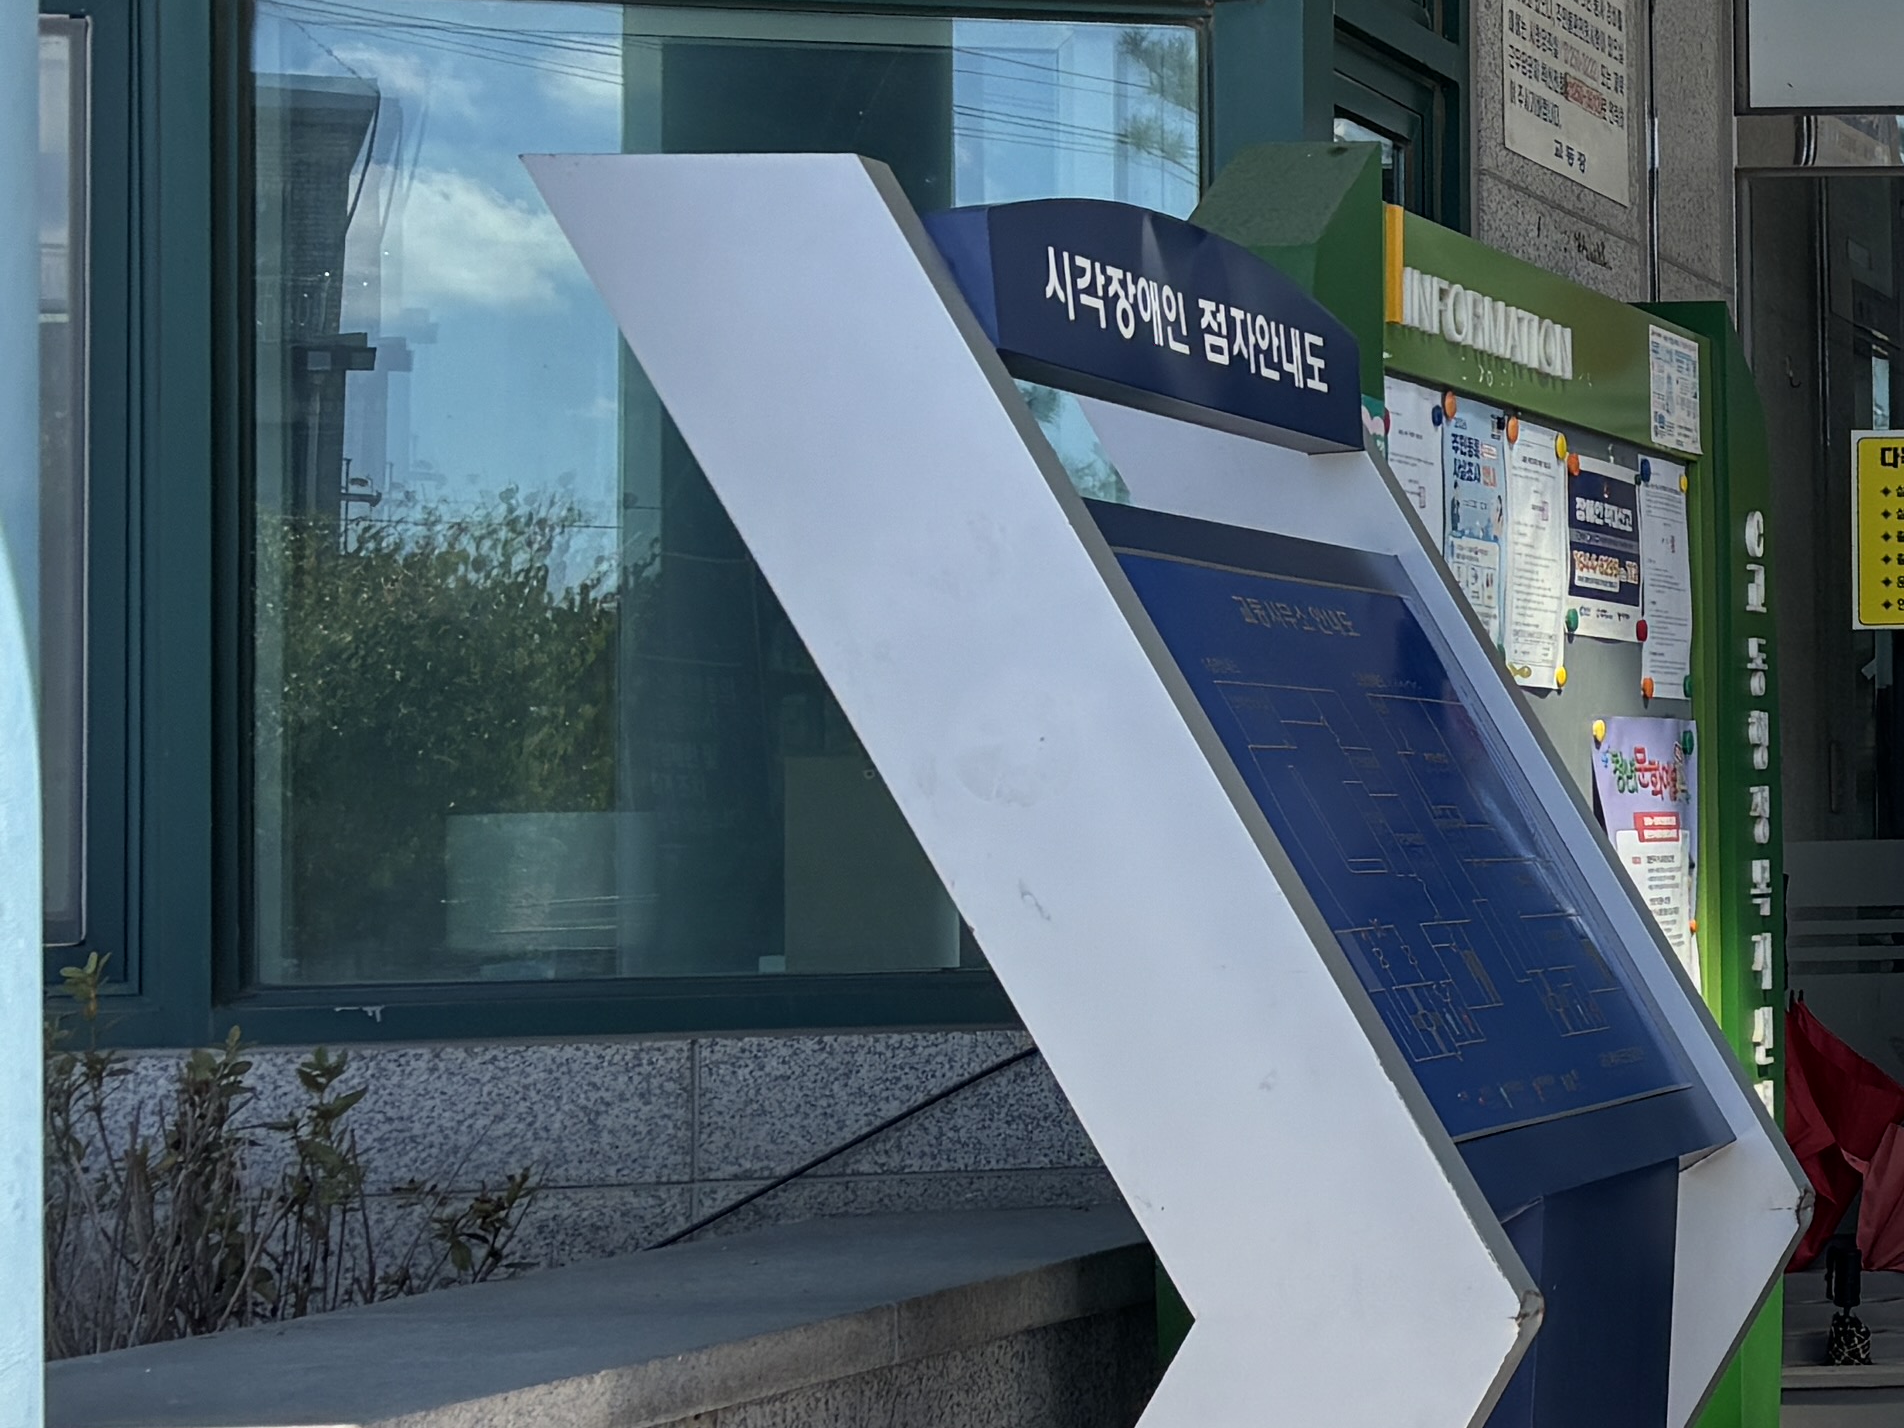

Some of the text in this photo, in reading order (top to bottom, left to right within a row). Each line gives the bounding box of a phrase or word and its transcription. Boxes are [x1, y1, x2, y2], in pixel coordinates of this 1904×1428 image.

[1046, 246, 1328, 393] 시각장애인 점자안내도
[1403, 265, 1573, 381] INFORMATION
